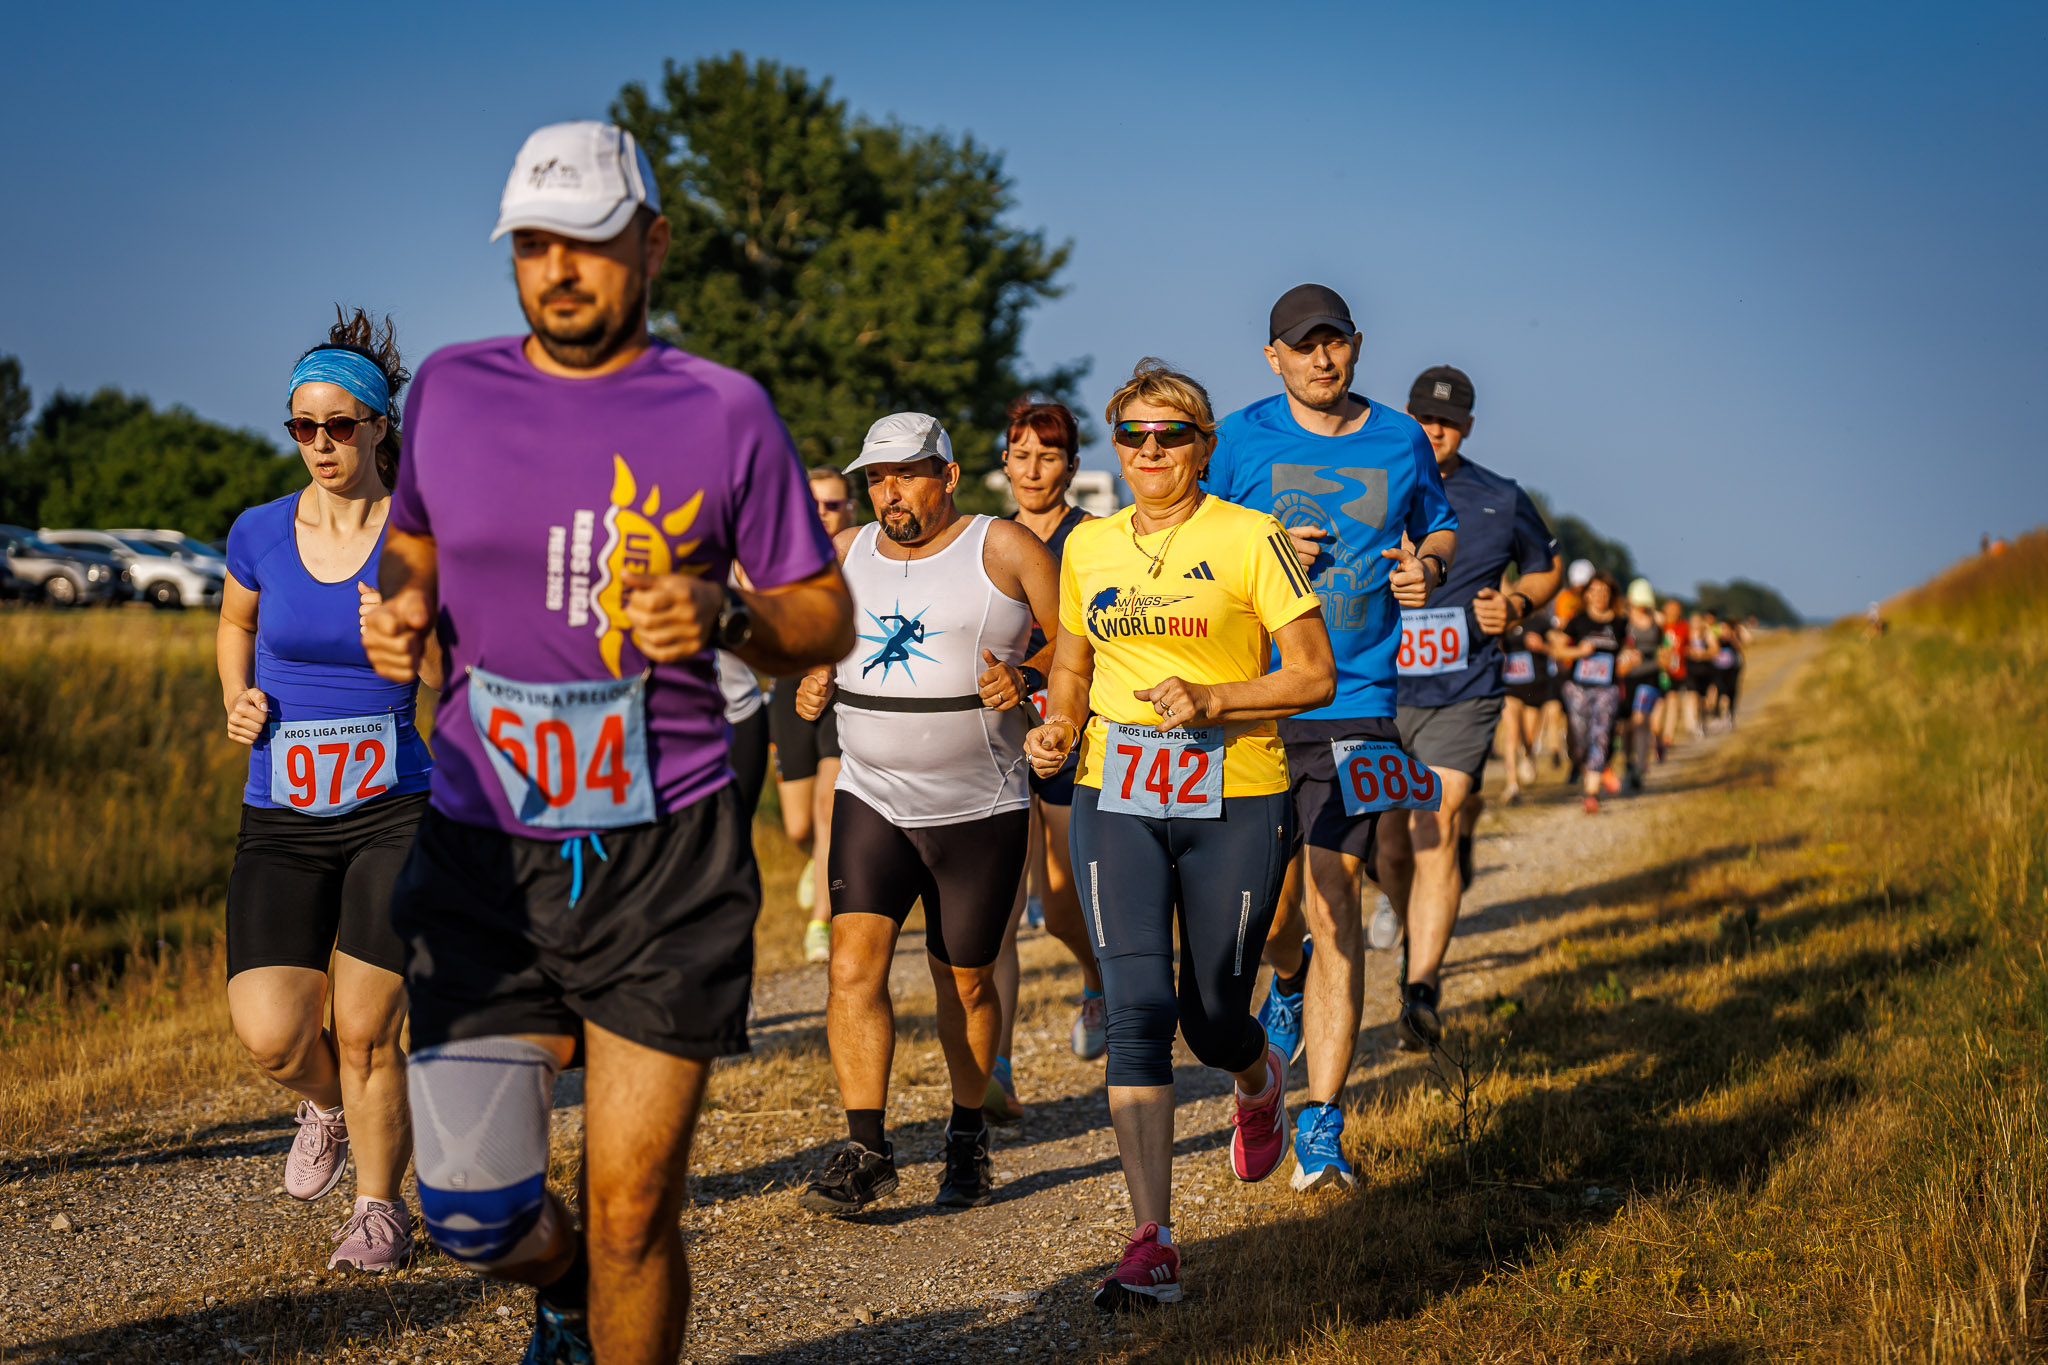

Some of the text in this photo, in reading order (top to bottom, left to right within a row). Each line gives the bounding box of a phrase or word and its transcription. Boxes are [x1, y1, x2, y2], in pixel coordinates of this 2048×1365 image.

[1118, 595, 1162, 607] WINGS
[1123, 607, 1148, 616] LIFE
[1101, 616, 1208, 638] WORLD RUN
[1397, 626, 1459, 668] 859
[485, 682, 525, 702] KROS
[527, 692, 564, 708] LIGA
[284, 723, 382, 739] KROS LIGA PRELOG
[1118, 725, 1208, 740] KROS LIGA PRELOG
[488, 705, 632, 809] 504
[1343, 744, 1367, 752] KROS
[286, 739, 388, 807] 972
[1117, 744, 1209, 804] 742
[1349, 754, 1434, 803] 689
